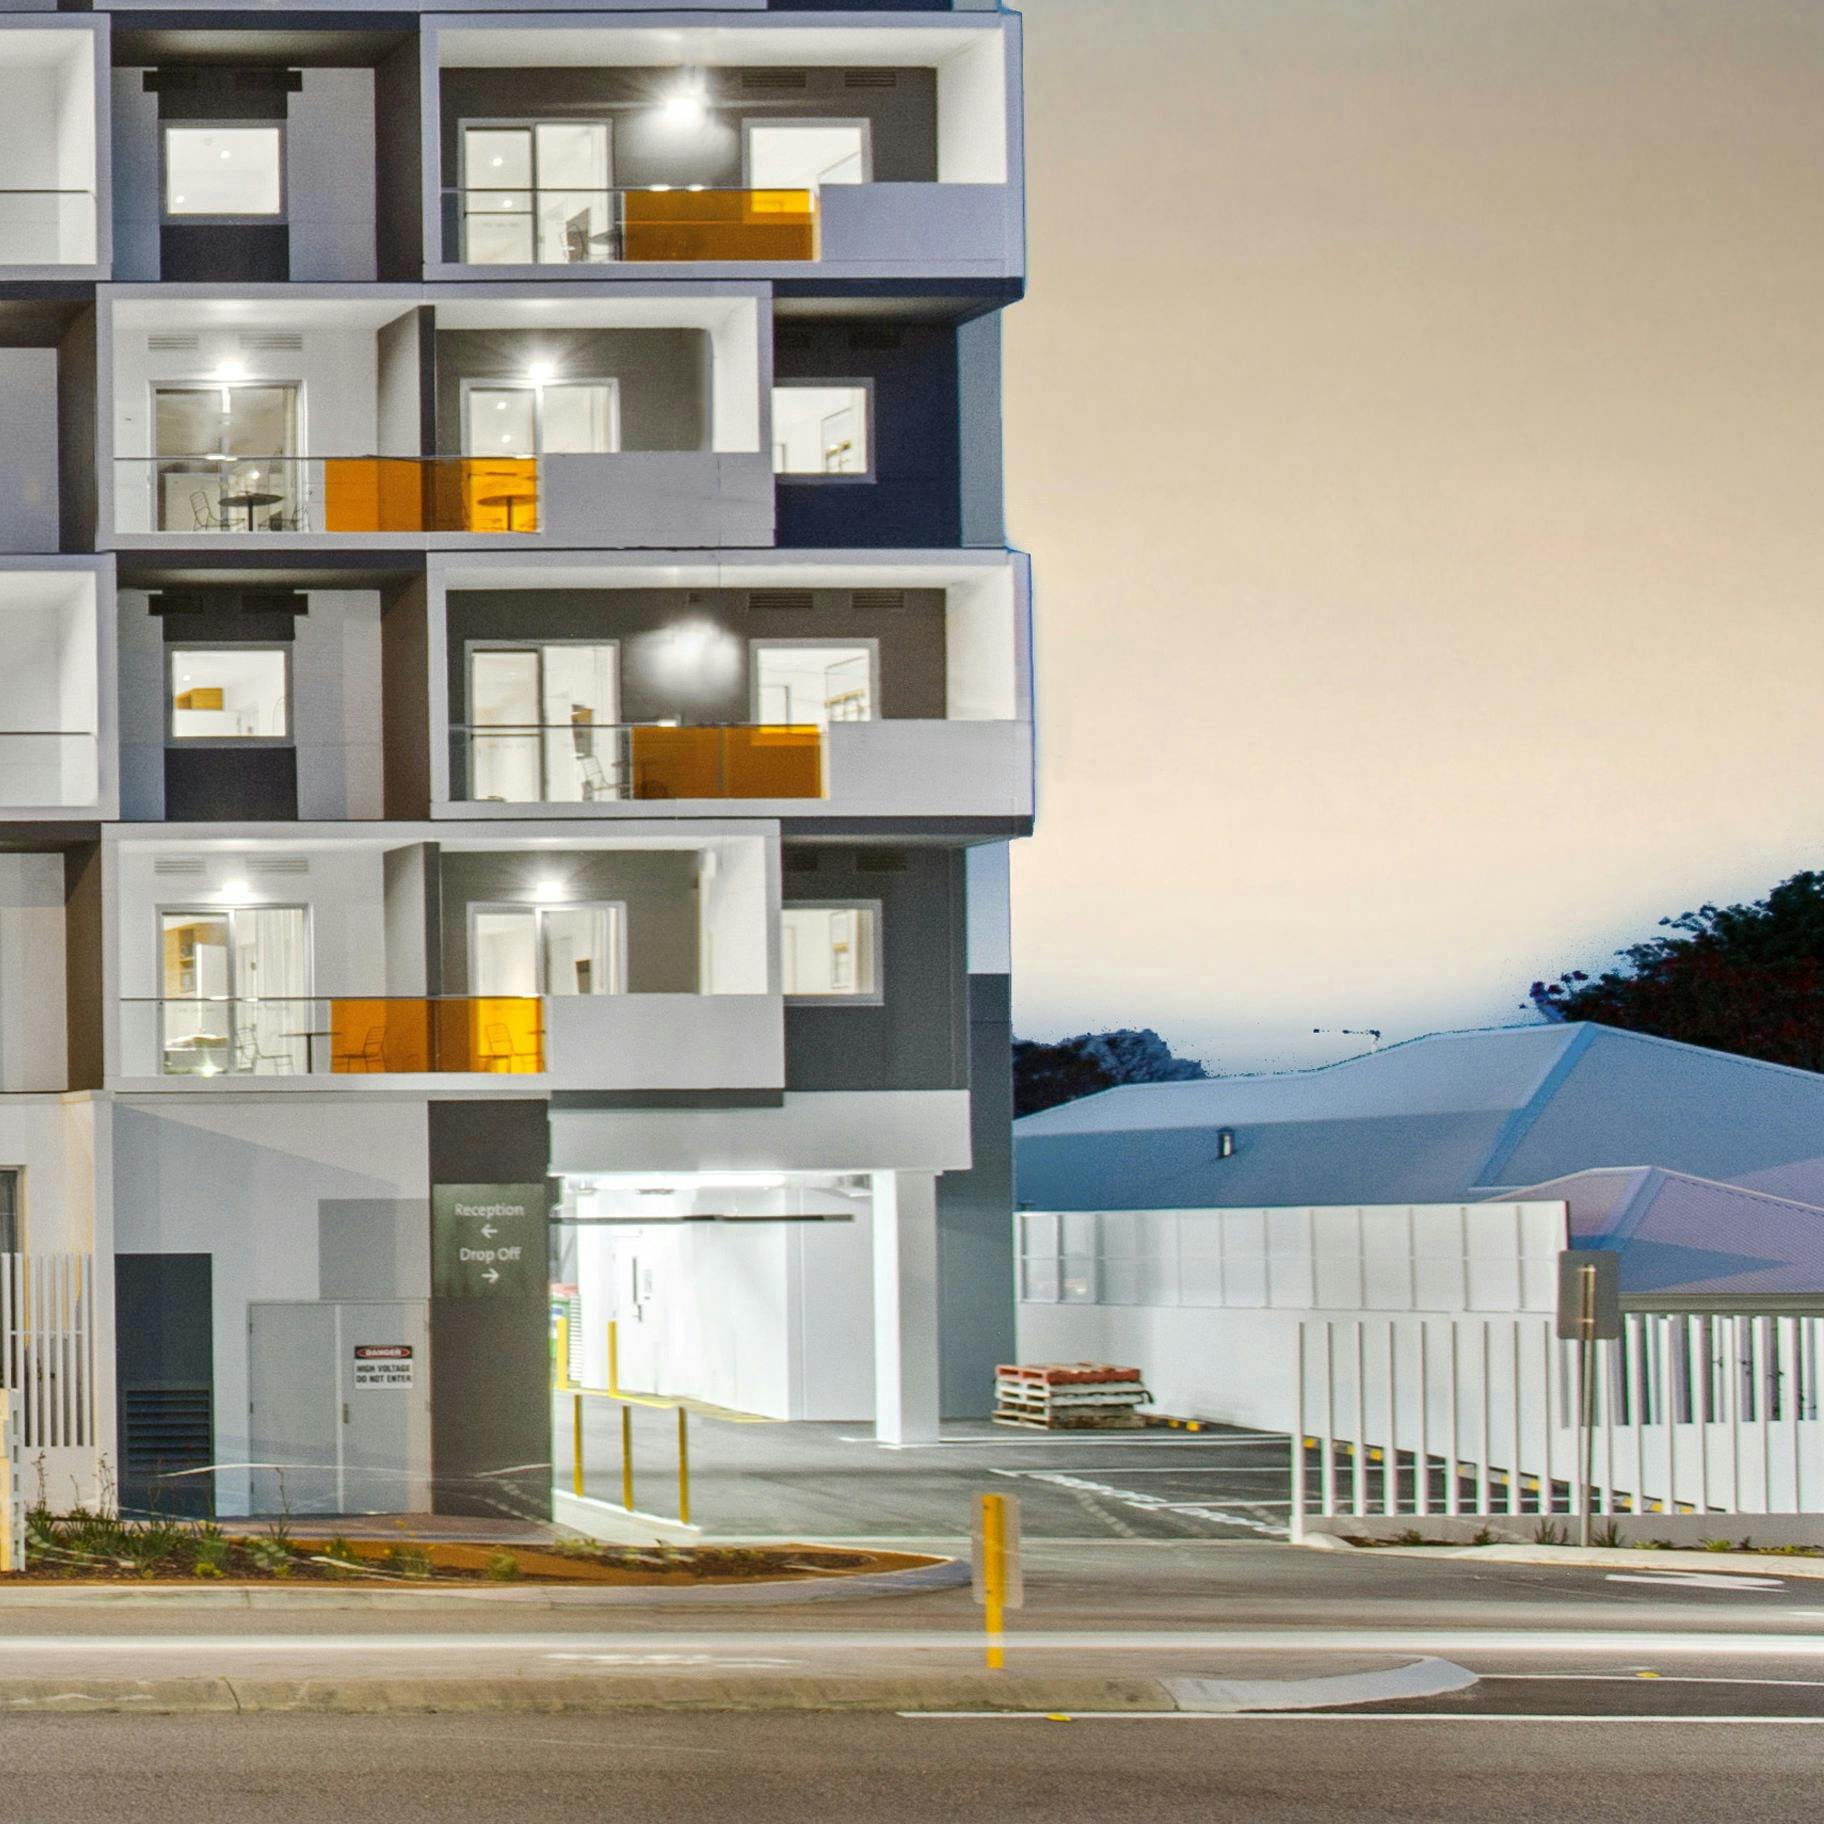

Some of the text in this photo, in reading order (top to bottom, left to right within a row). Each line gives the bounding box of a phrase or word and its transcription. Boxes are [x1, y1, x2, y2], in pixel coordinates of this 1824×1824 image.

[455, 1203, 524, 1219] Reception
[460, 1246, 522, 1264] Drop Off
[377, 1364, 409, 1372] VOLTAGE
[356, 1375, 411, 1383] DO NOT ENTER
